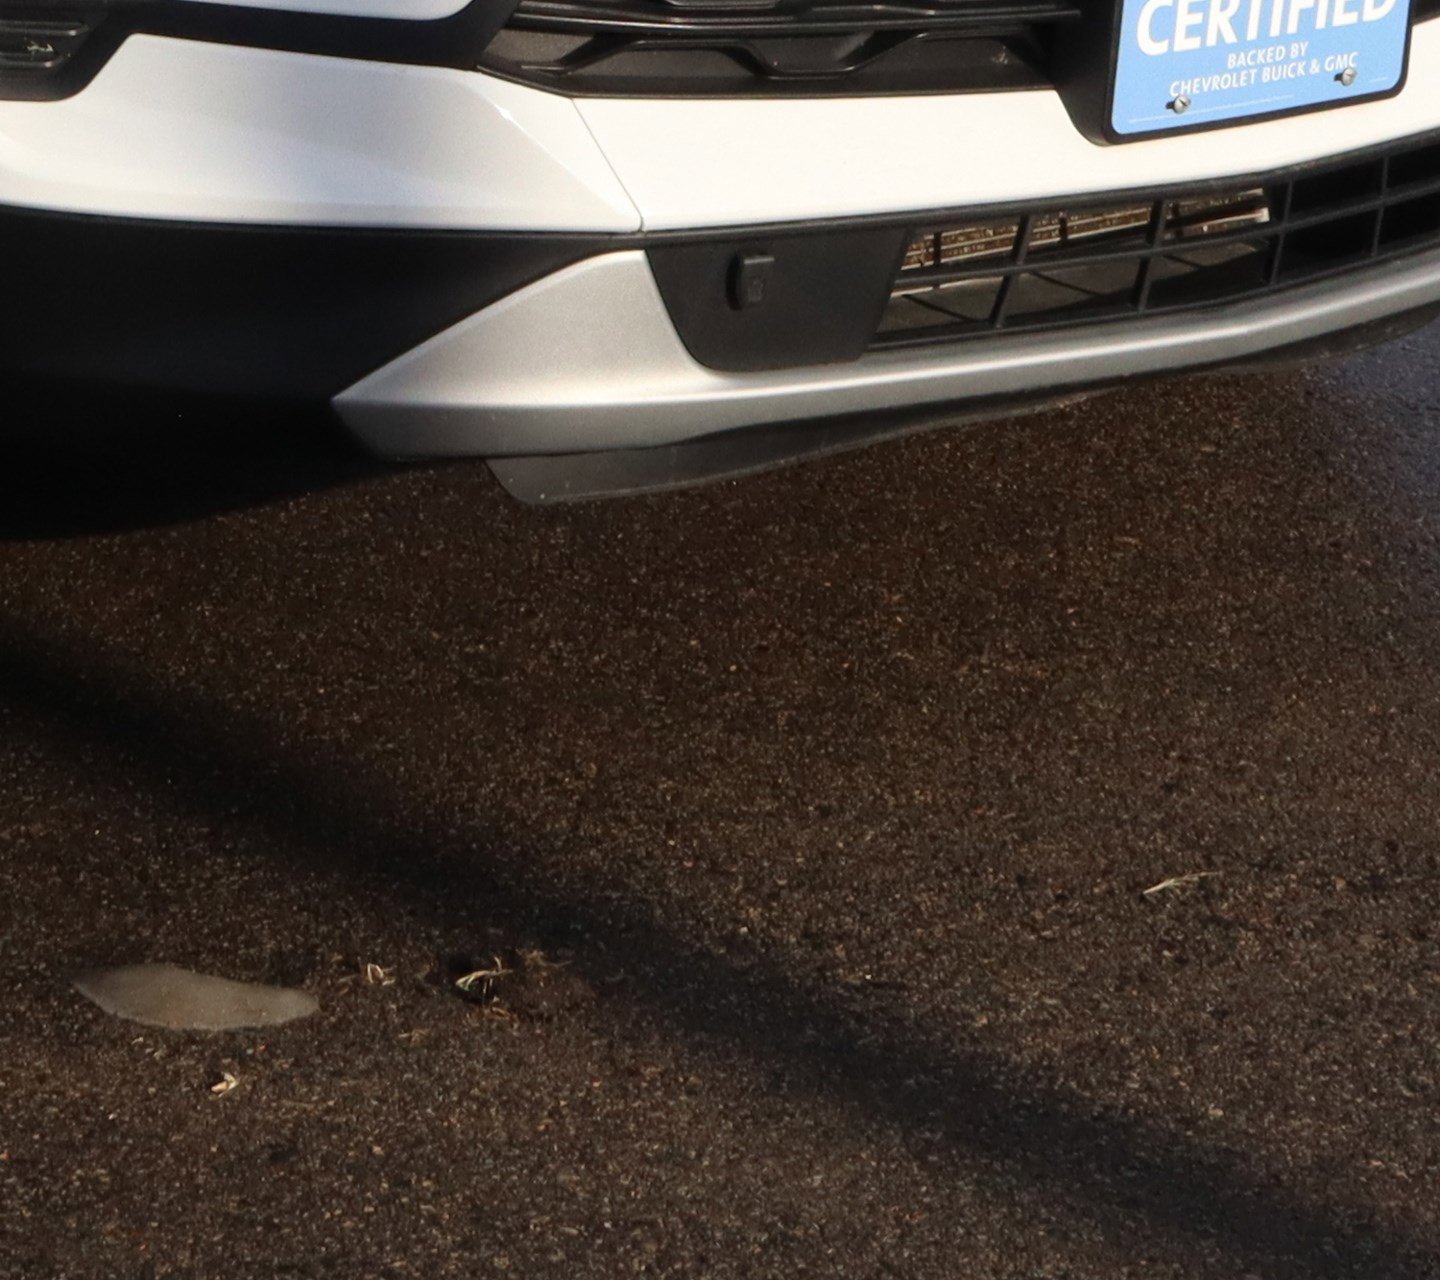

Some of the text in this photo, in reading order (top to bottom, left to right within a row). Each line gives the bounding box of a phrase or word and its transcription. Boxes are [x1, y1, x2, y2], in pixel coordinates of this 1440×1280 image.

[1169, 51, 1359, 98] CHEVROLET BUICK & GMC
[1227, 41, 1309, 70] BACKED BY
